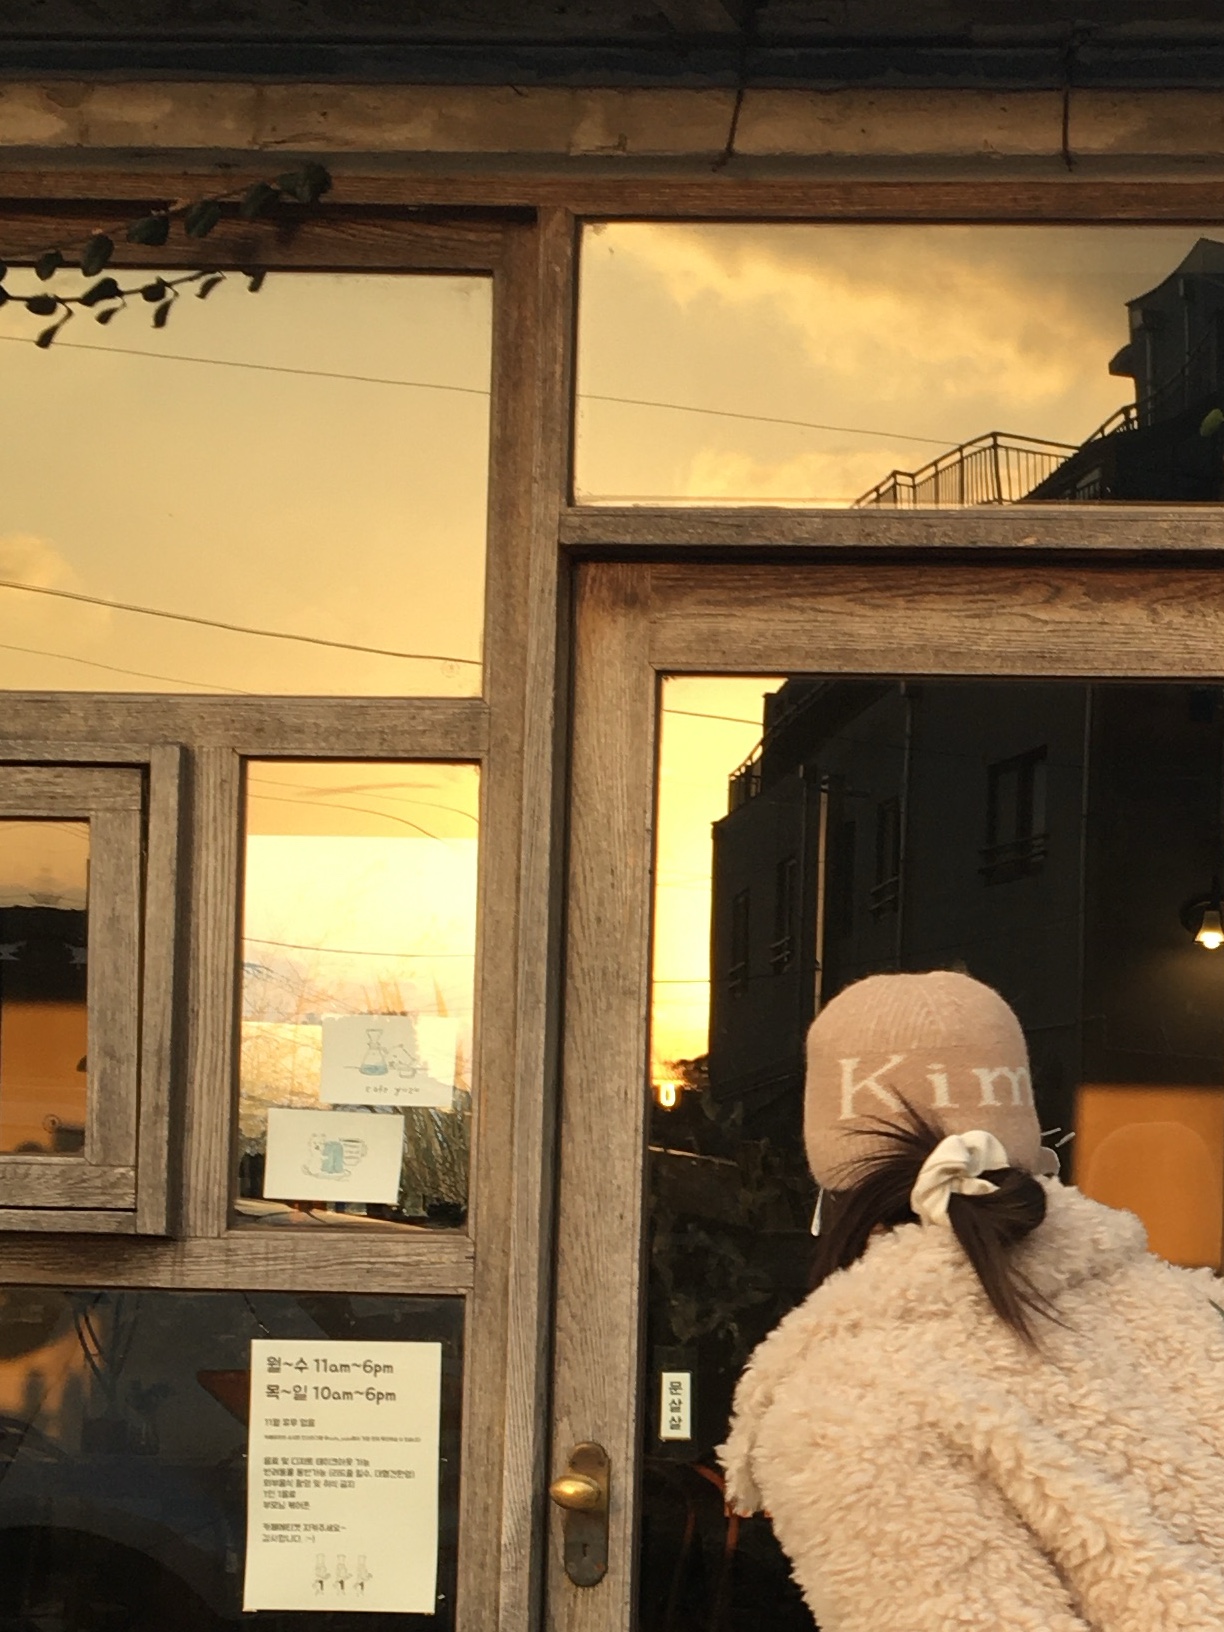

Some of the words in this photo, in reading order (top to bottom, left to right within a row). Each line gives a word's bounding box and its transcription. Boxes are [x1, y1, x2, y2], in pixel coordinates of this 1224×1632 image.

[837, 1054, 1035, 1120] Kim
[267, 1356, 309, 1373] 월~수
[314, 1358, 394, 1378] 11am~6pm
[266, 1384, 307, 1400] 목~일
[313, 1386, 396, 1405] 10am~6pm
